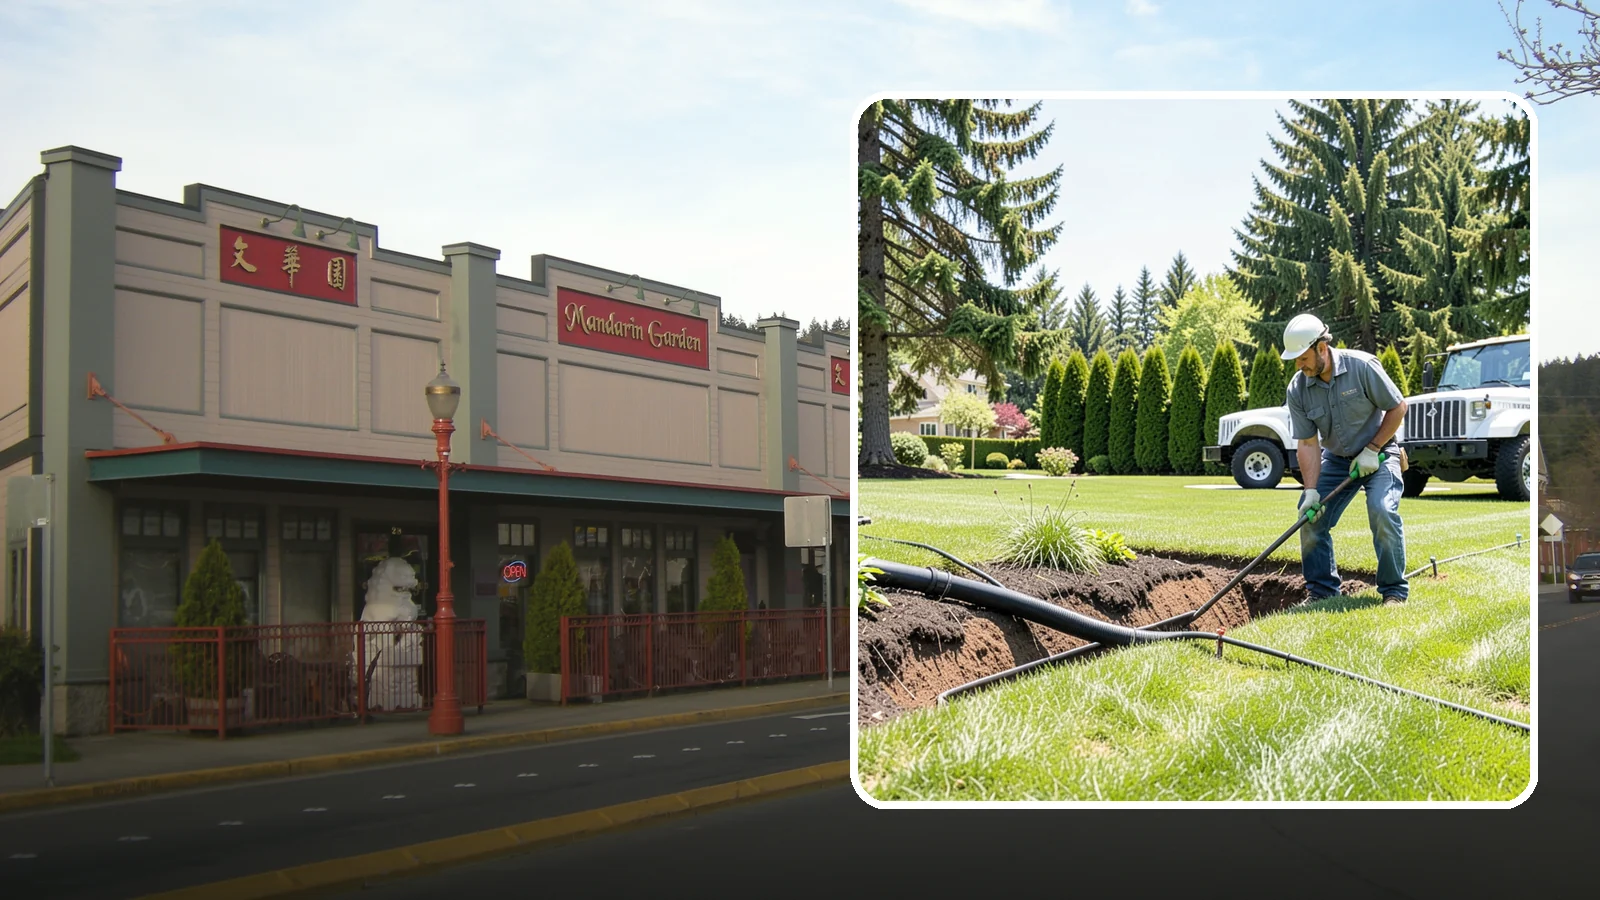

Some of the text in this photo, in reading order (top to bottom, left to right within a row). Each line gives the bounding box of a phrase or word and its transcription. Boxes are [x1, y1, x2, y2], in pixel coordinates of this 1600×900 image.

[231, 235, 346, 291] 文華園
[564, 302, 701, 352] Mandarin Garden
[835, 363, 846, 386] 文
[503, 565, 526, 578] OPEN
